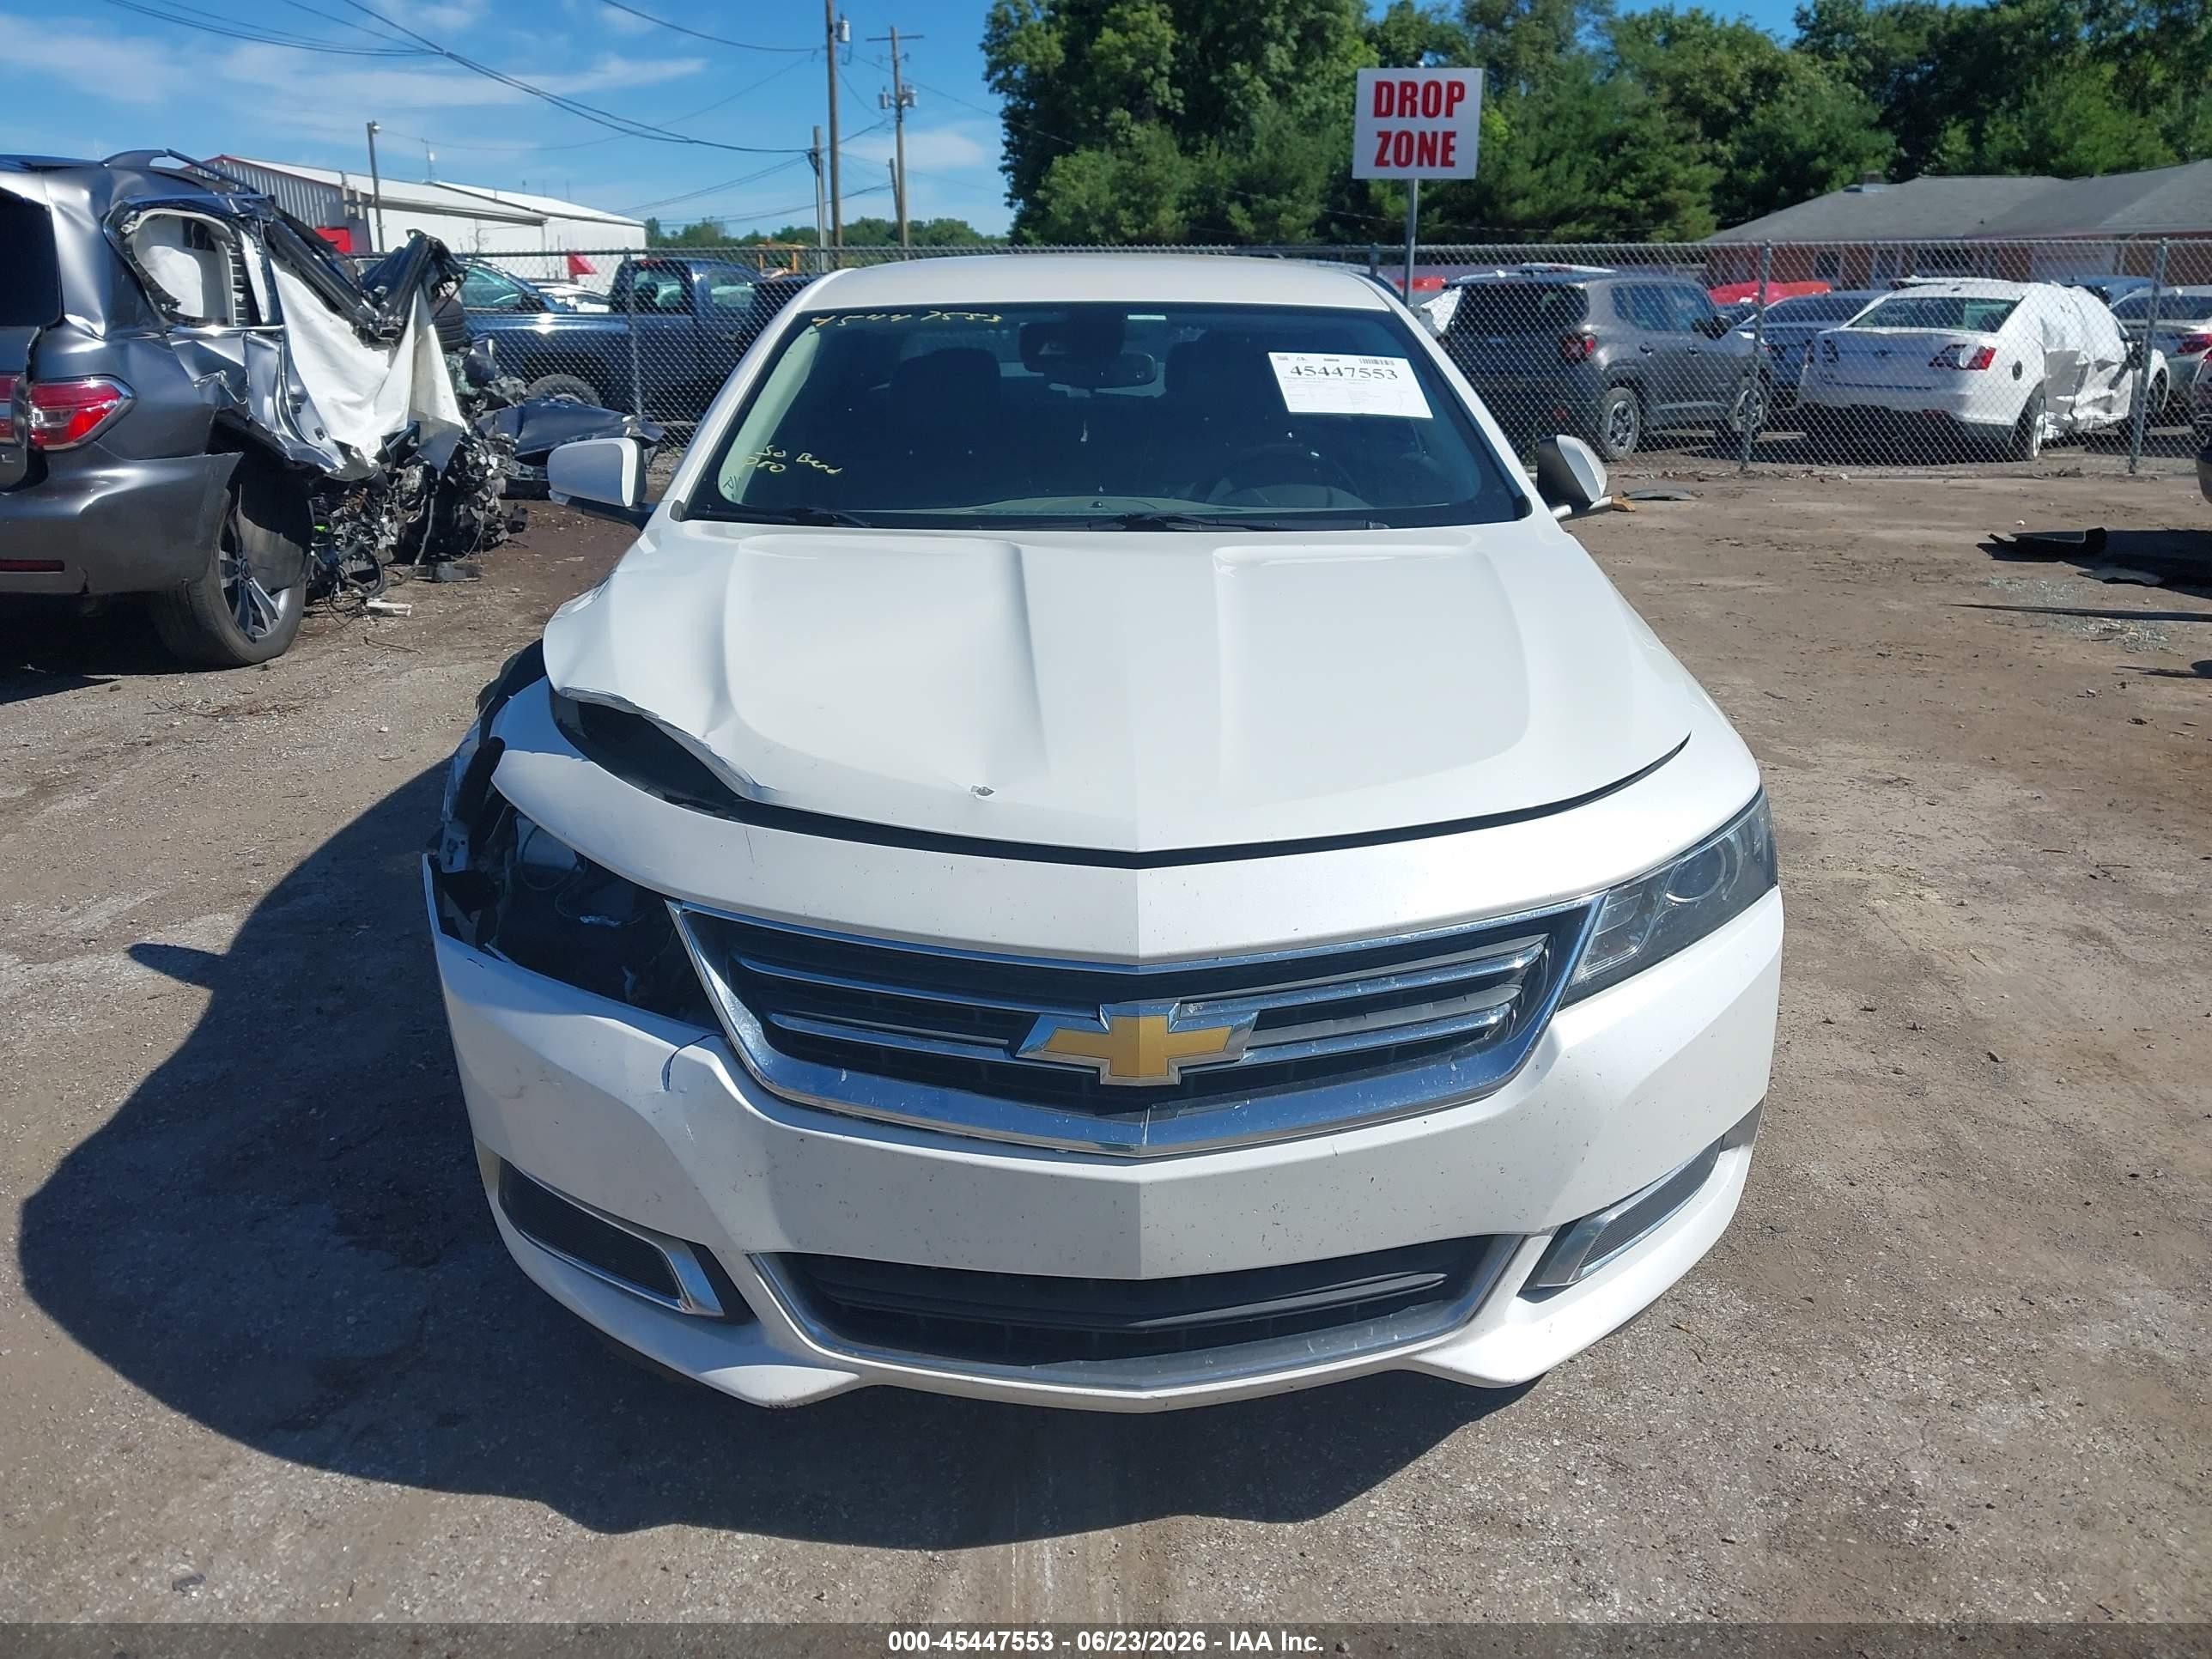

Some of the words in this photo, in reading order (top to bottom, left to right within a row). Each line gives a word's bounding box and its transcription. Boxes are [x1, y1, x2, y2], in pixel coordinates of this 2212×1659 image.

[1372, 80, 1466, 118] DROP
[1374, 130, 1457, 168] ZONE
[1290, 365, 1398, 380] 45447553
